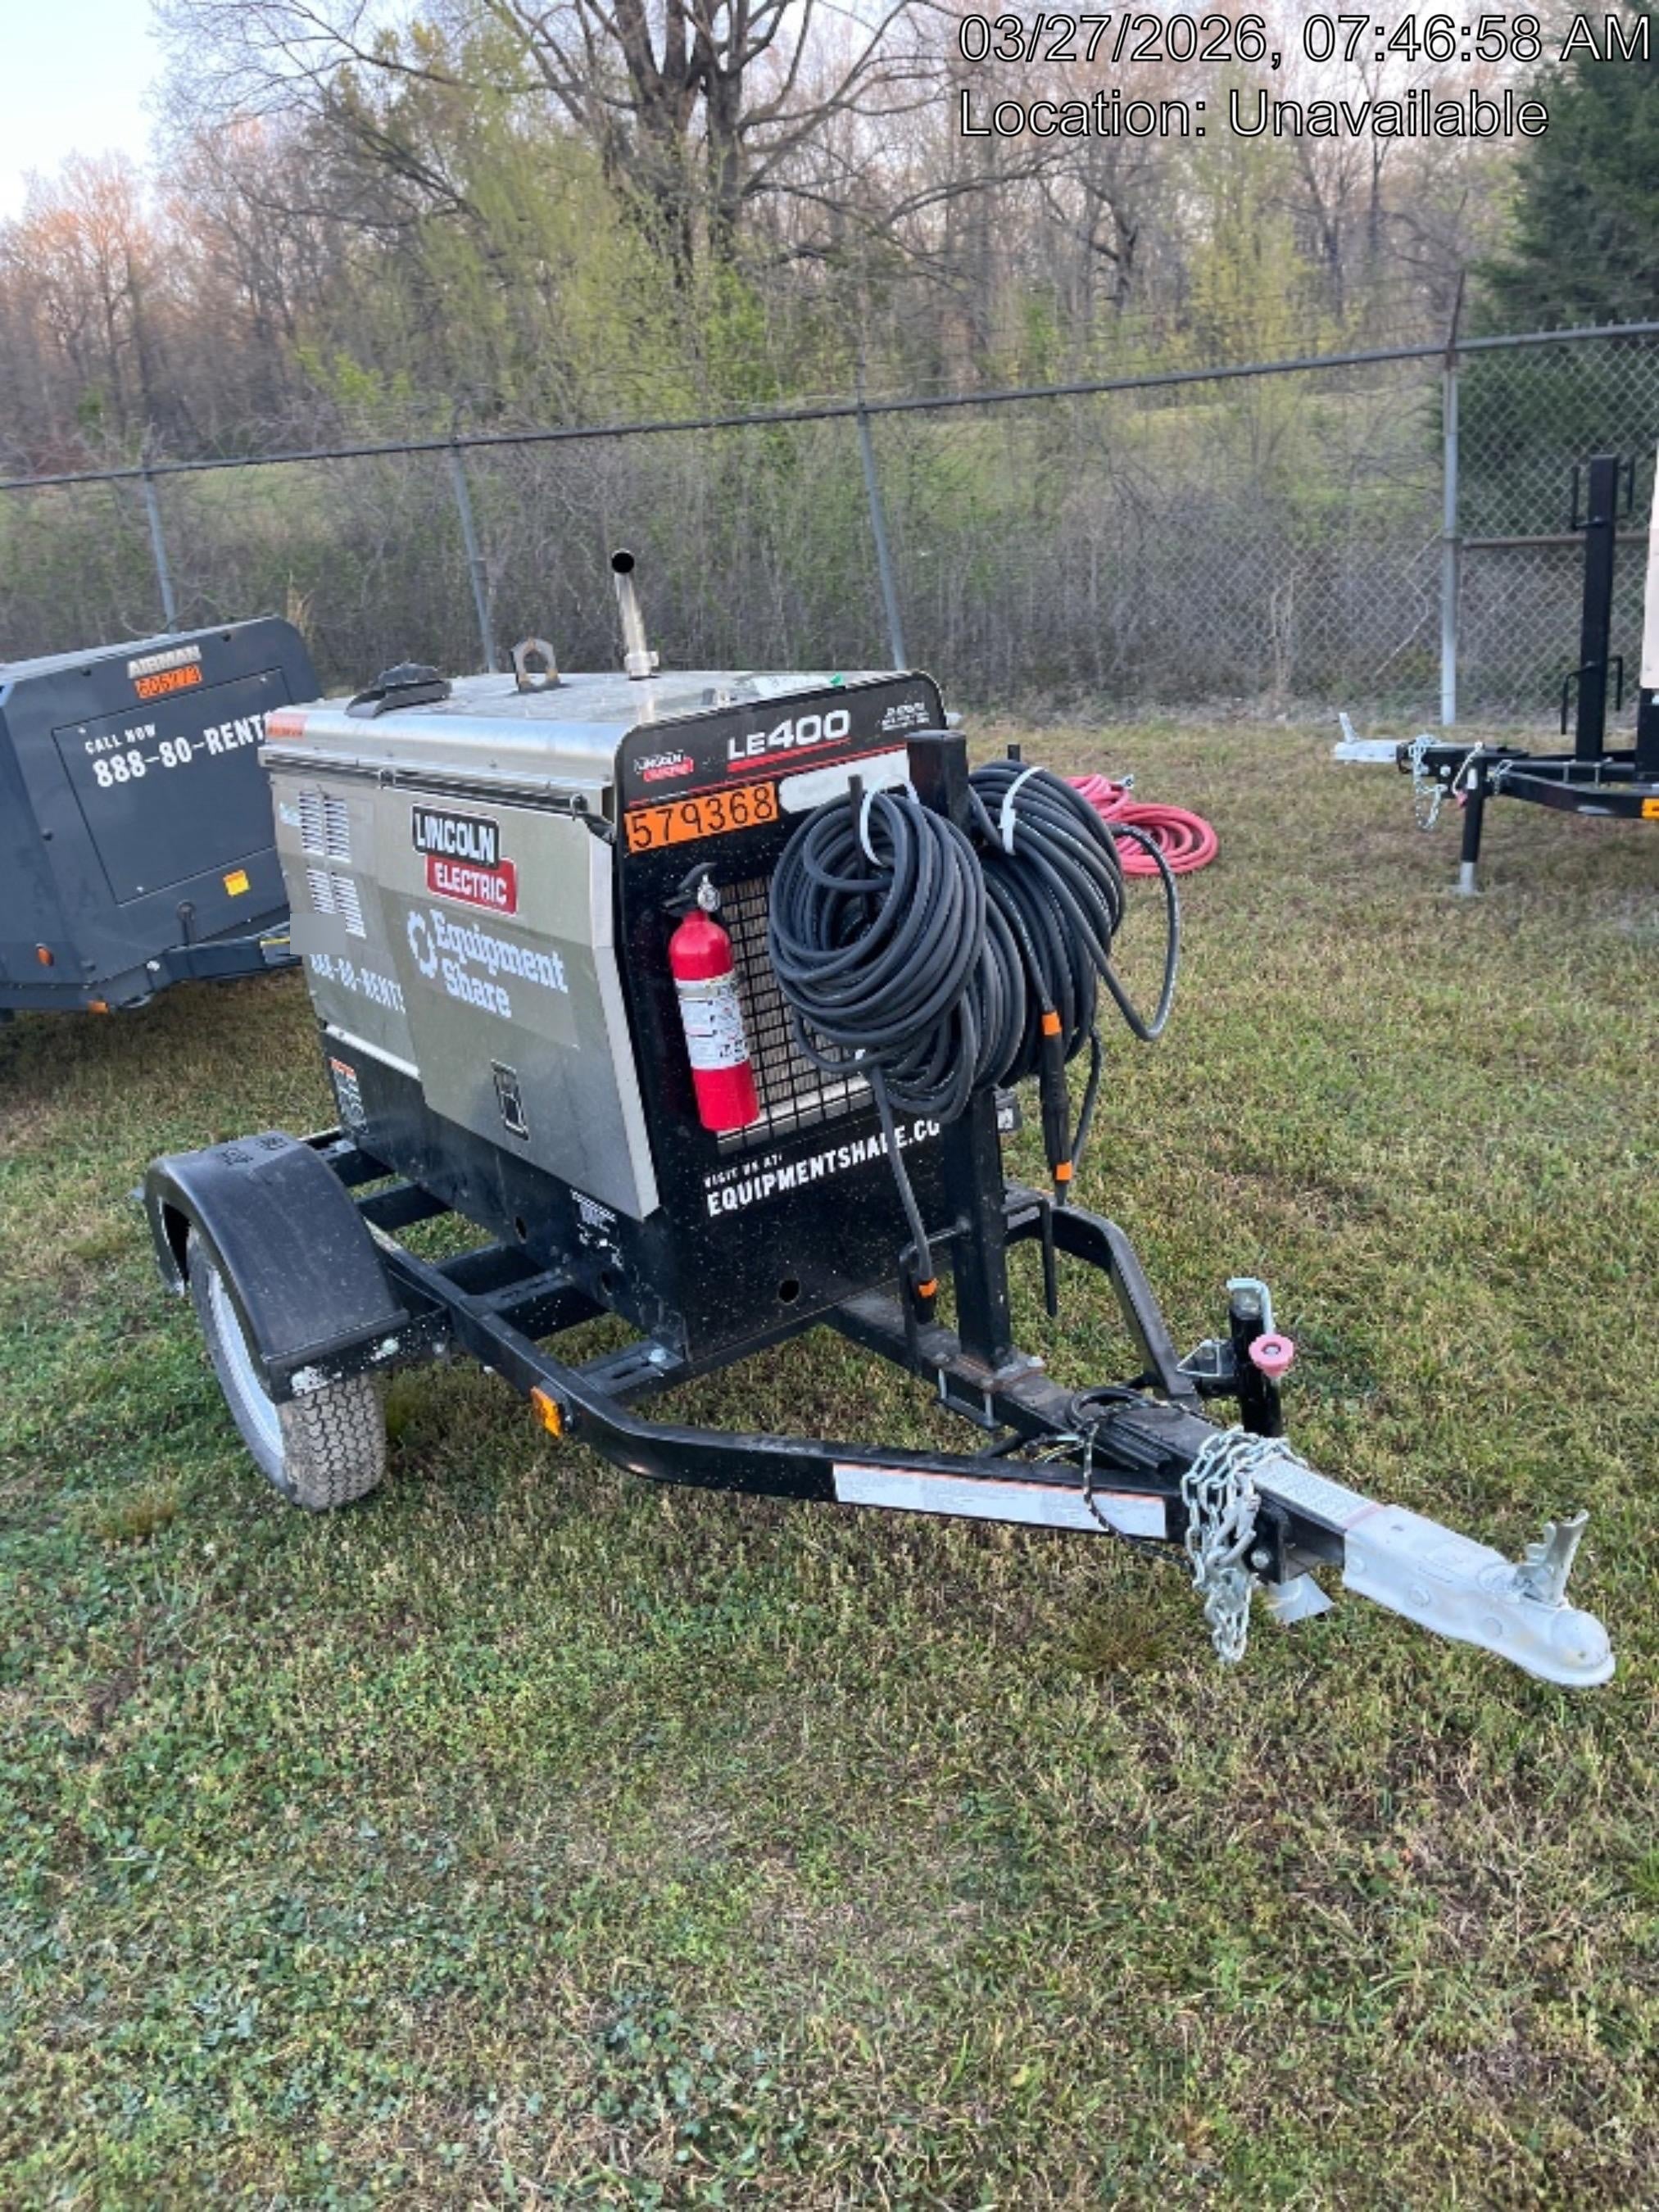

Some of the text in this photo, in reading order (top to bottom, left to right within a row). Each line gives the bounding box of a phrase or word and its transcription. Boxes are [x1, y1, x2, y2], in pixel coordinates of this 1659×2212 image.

[84, 723, 156, 755] CALL NOW
[93, 710, 271, 787] 888-80-RENT
[728, 709, 852, 759] LE400
[415, 813, 495, 864] LINCOLN
[630, 786, 773, 849] 579368
[434, 863, 507, 904] ELECTRIC
[430, 909, 569, 994] Equipment
[442, 957, 512, 1018] Share
